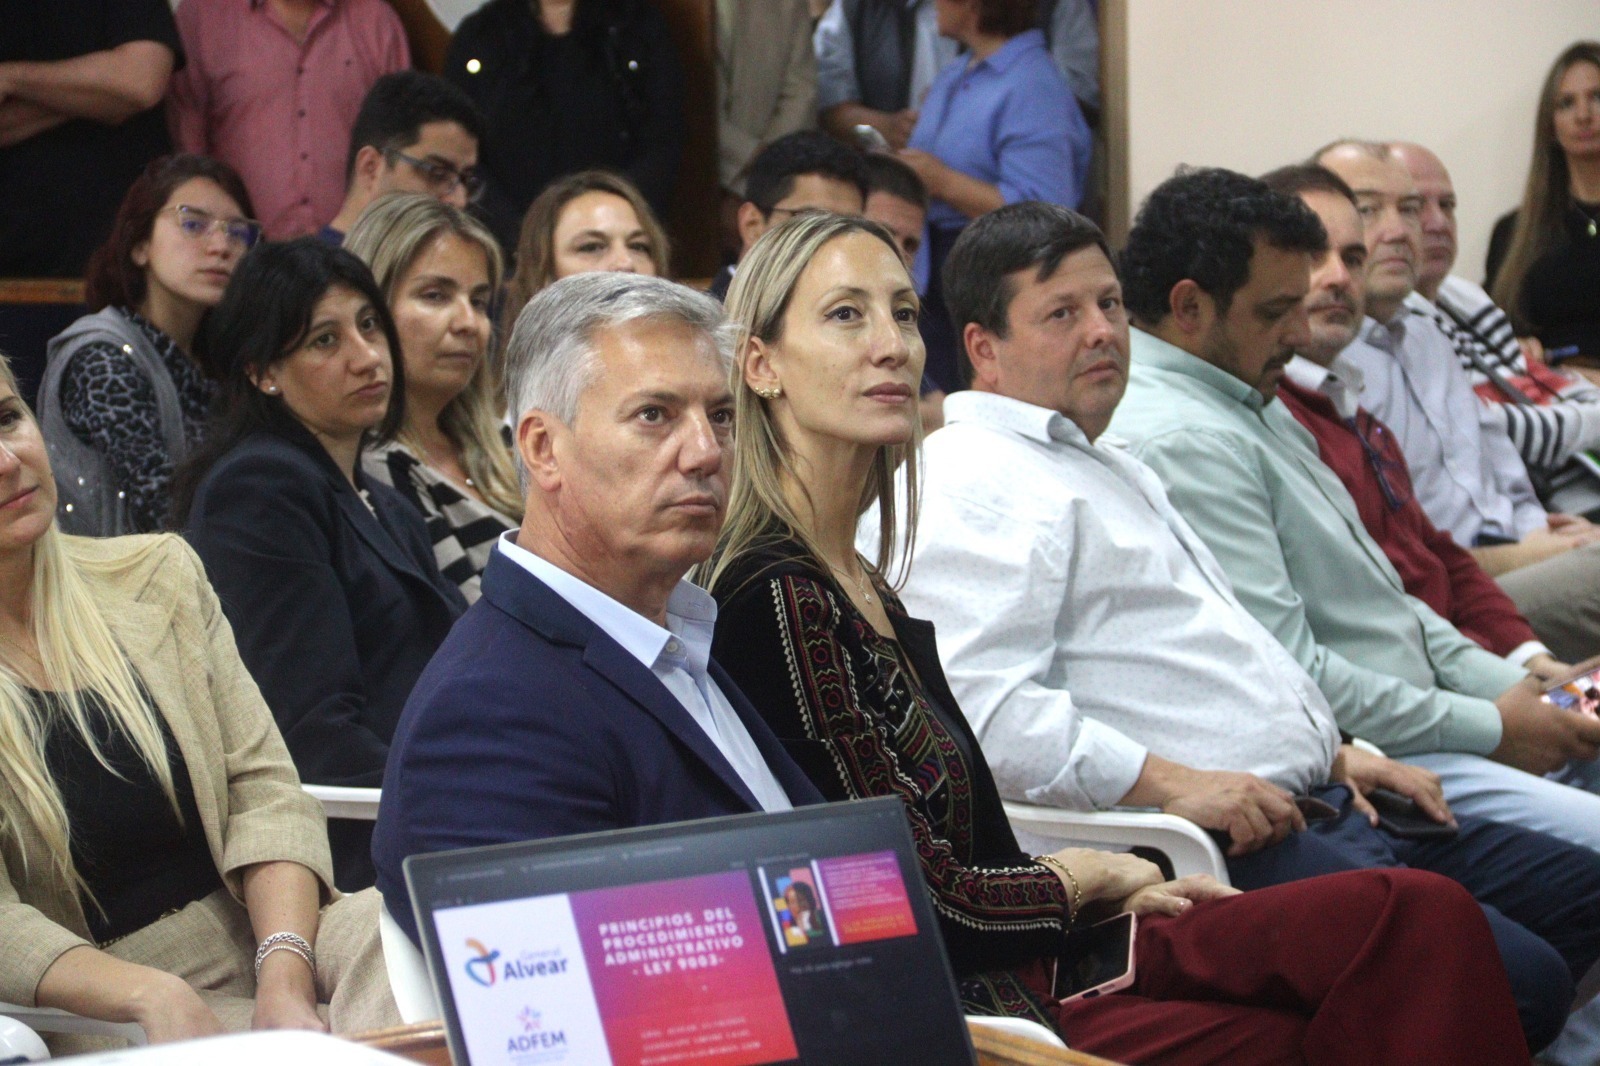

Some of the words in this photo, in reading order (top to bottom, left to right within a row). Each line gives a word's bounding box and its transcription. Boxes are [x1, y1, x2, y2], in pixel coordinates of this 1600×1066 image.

[598, 912, 694, 937] PRINCIPIOS
[703, 907, 734, 923] DEL
[602, 921, 738, 951] PROCEDIMIENTO
[604, 935, 744, 966] ADMINISTRATIVO
[504, 958, 567, 981] Alvear
[643, 960, 672, 977] LEY
[507, 1029, 567, 1053] ADFEM
